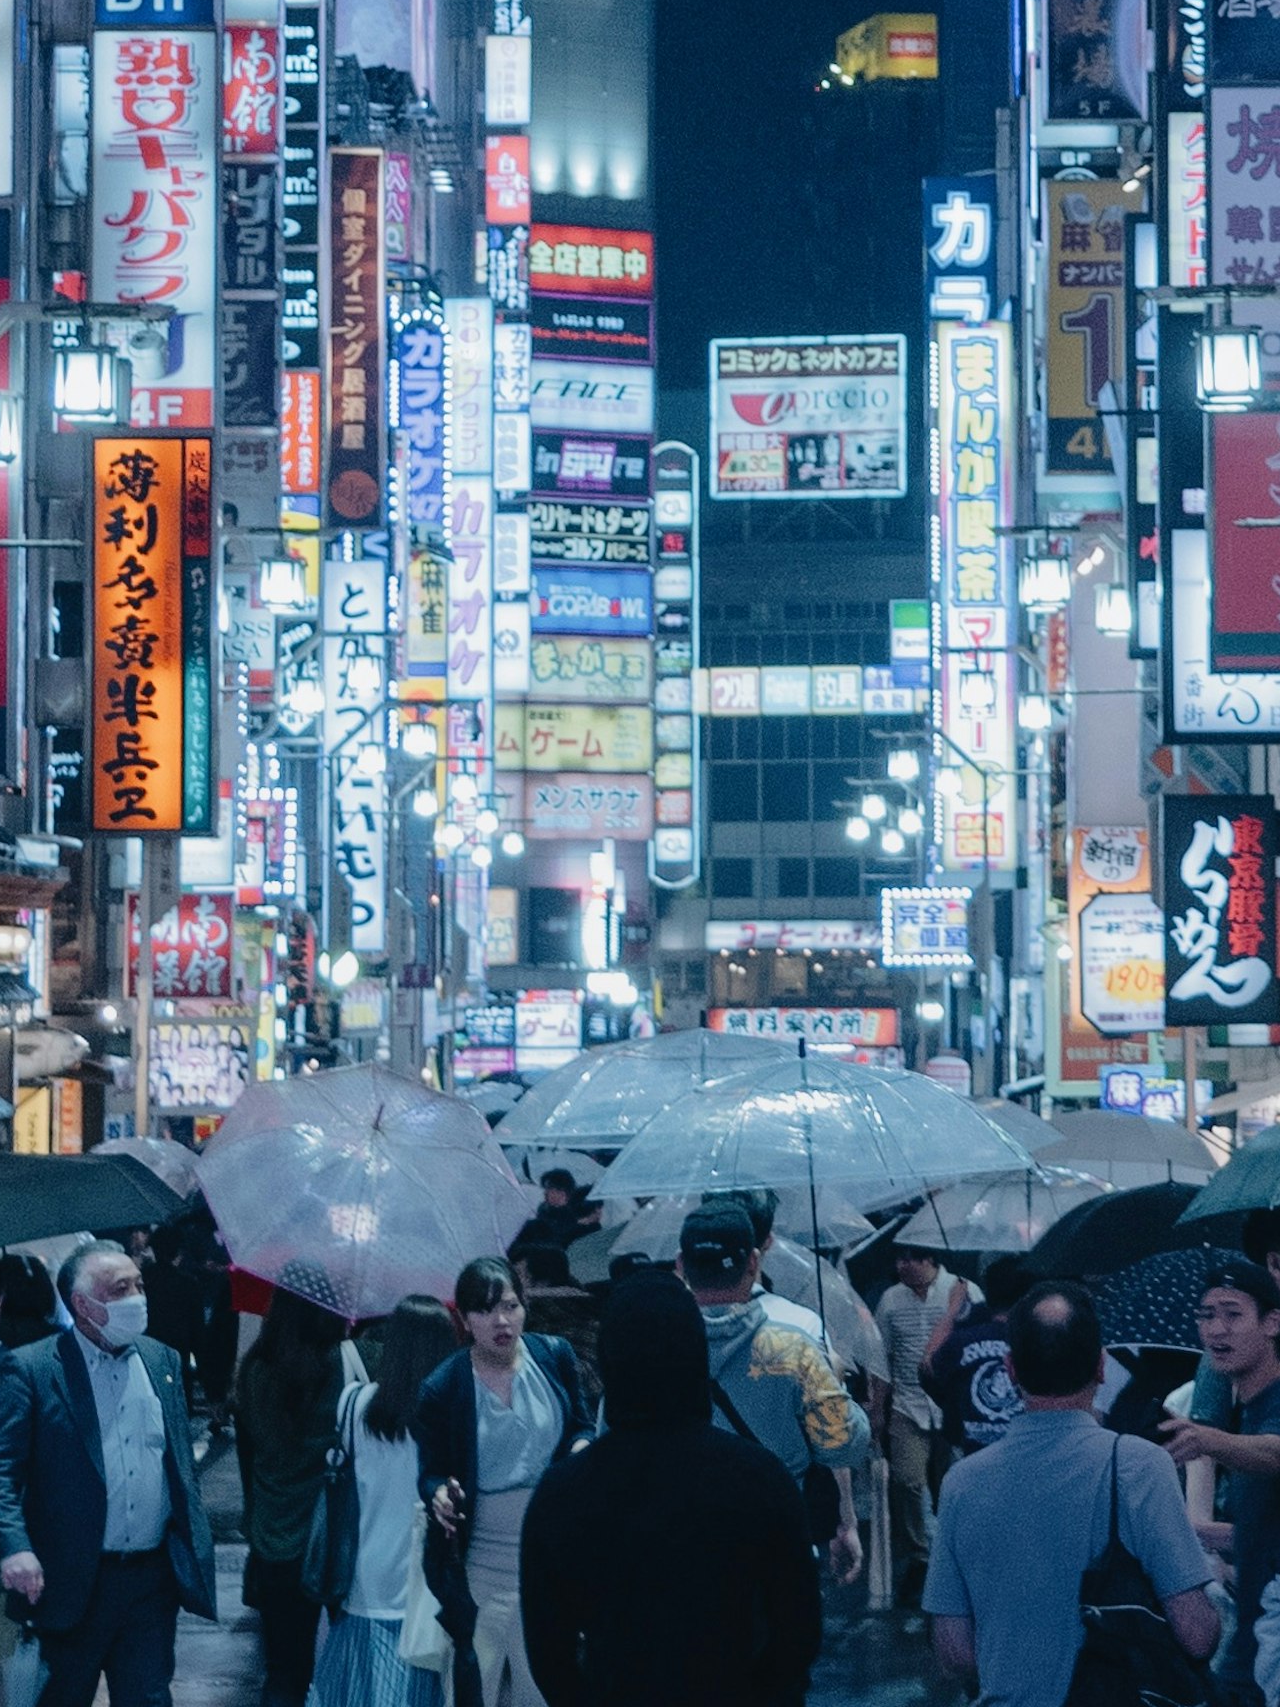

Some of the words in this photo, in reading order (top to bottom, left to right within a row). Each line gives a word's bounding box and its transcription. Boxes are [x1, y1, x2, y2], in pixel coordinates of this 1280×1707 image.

[529, 239, 648, 281] 全店営業中
[1060, 292, 1112, 406] 1
